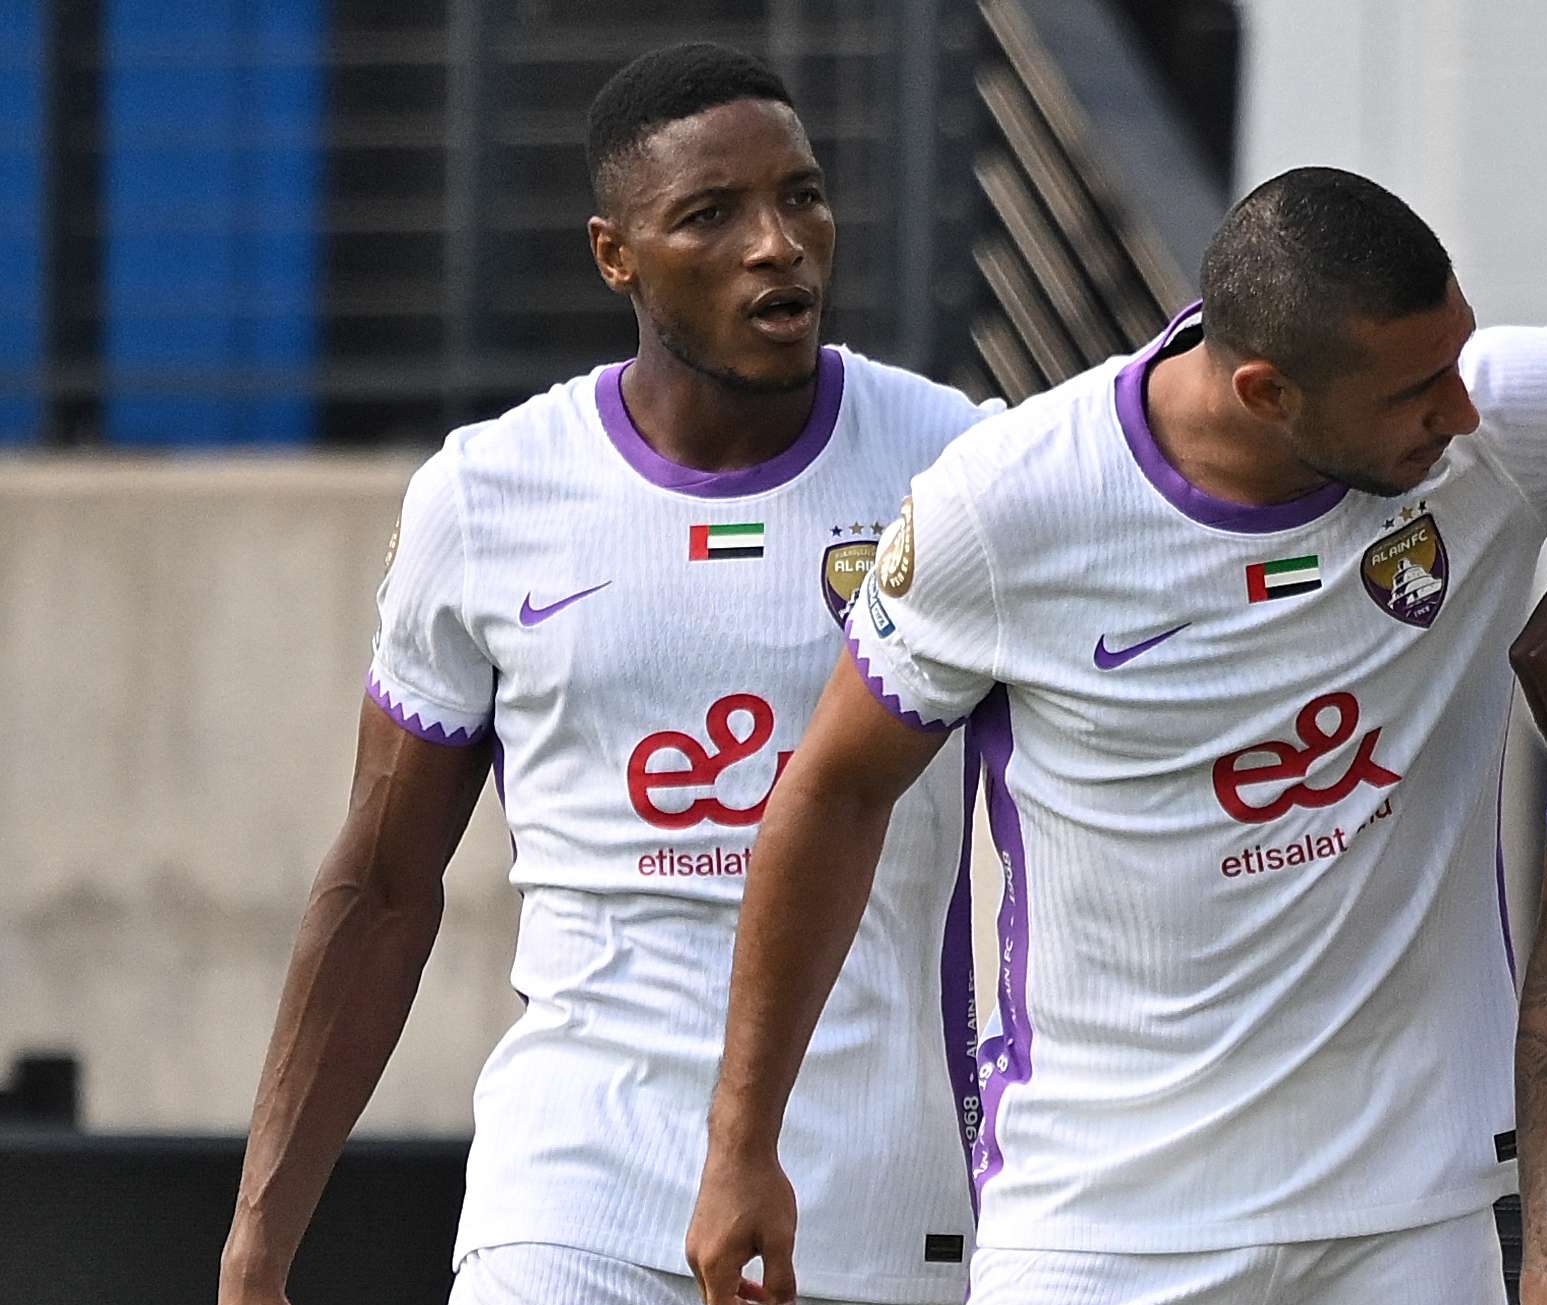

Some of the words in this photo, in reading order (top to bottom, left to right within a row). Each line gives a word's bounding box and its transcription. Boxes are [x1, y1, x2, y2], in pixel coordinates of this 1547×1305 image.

[834, 559, 853, 573] AL
[1372, 552, 1388, 566] AL
[1389, 539, 1412, 557] AIN
[1412, 529, 1429, 546] FC
[638, 847, 752, 877] etisalat
[1220, 827, 1349, 879] etisalat
[963, 1095, 980, 1148] 968
